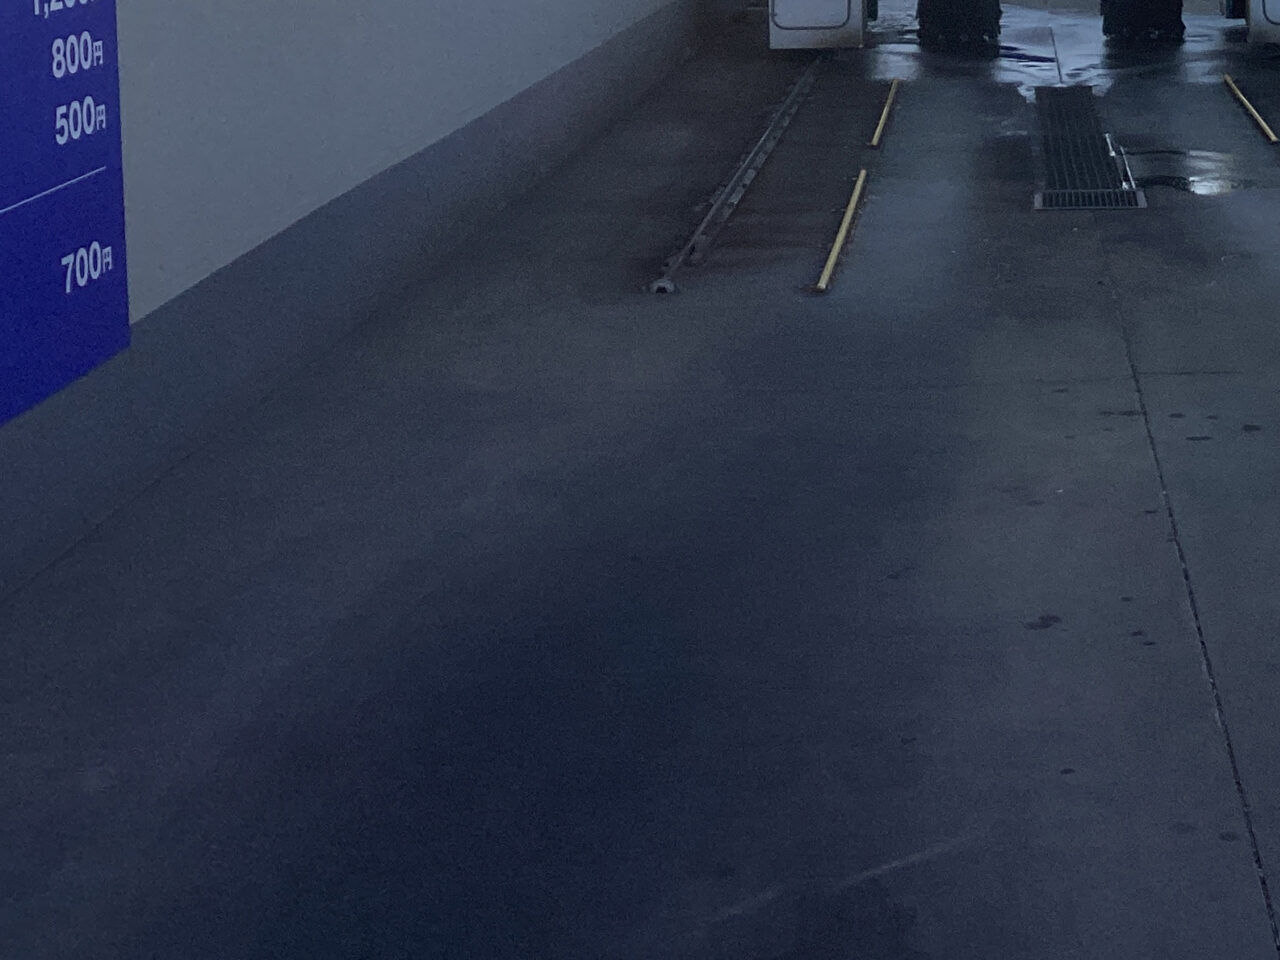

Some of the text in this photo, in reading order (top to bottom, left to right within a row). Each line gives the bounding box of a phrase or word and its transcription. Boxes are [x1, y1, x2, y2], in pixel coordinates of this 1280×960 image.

[51, 30, 104, 79] 800円
[55, 95, 107, 145] 500円
[61, 240, 113, 294] 700円
